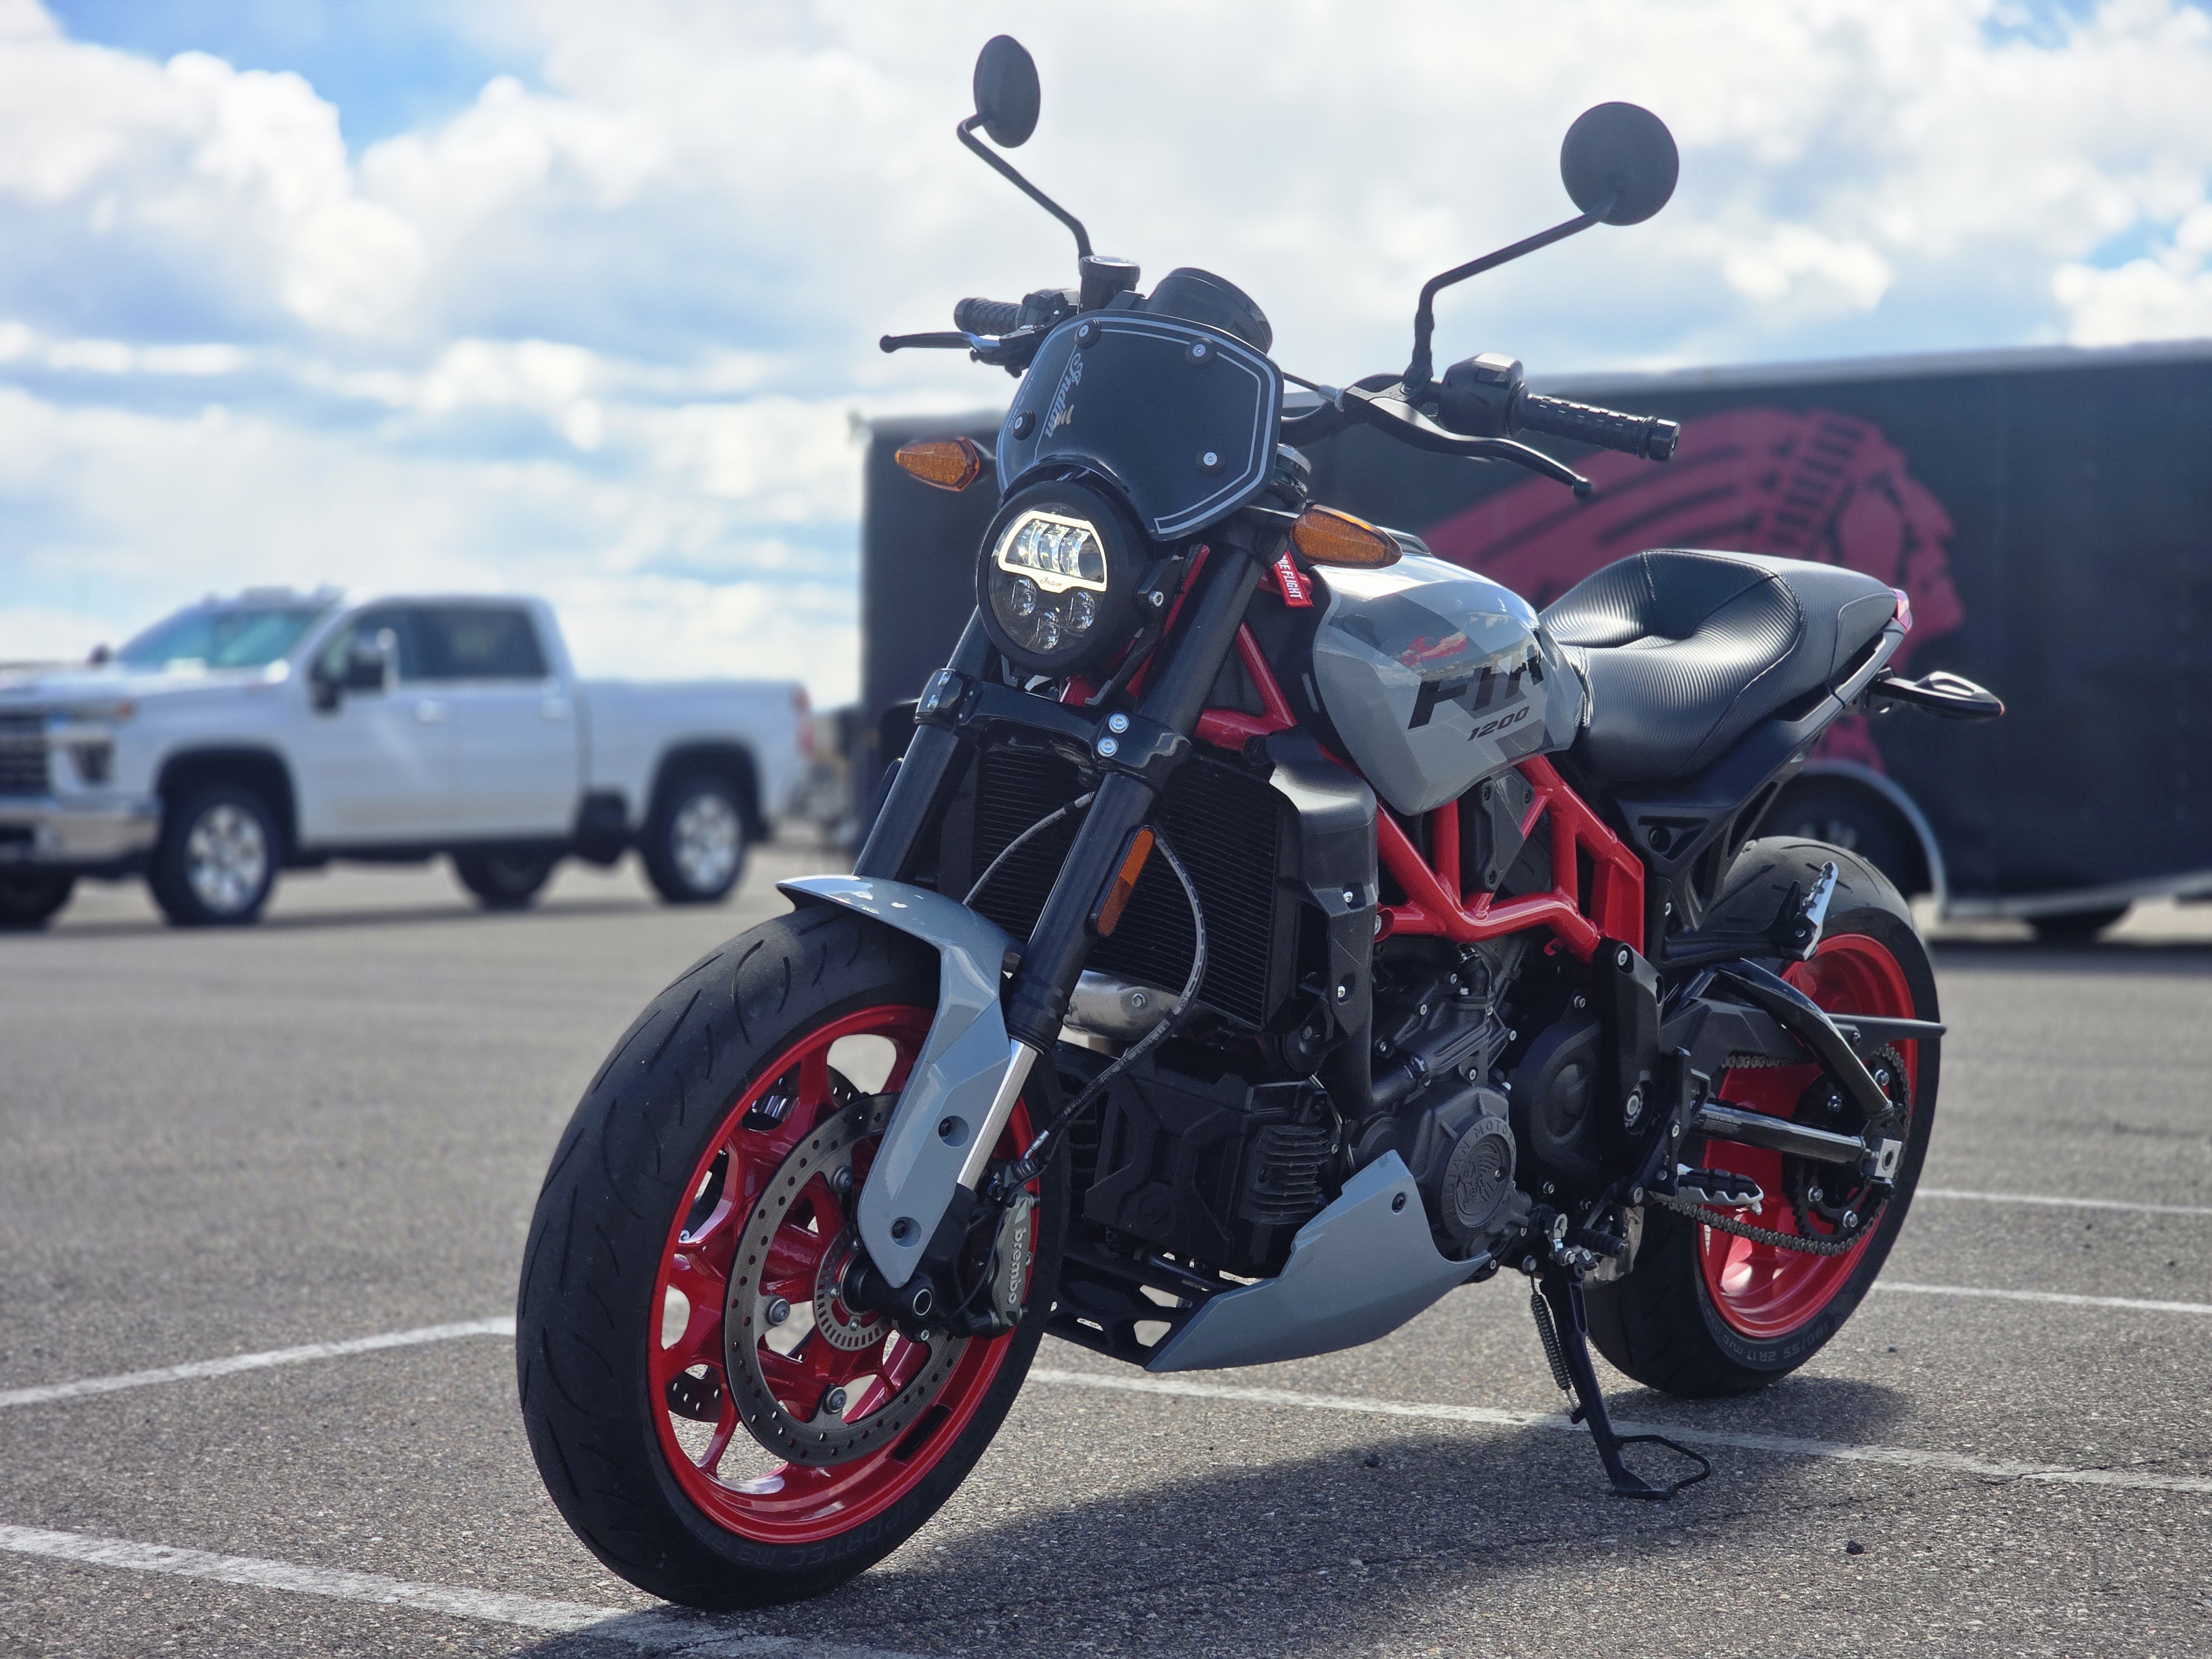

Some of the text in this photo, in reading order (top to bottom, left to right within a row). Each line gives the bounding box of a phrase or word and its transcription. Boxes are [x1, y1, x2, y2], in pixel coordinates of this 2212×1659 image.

[1045, 352, 1083, 438] Indian
[1039, 576, 1063, 587] Indian
[1280, 571, 1303, 599] FLIGHT
[1467, 706, 1530, 742] 1200
[1008, 1227, 1026, 1304] brembo
